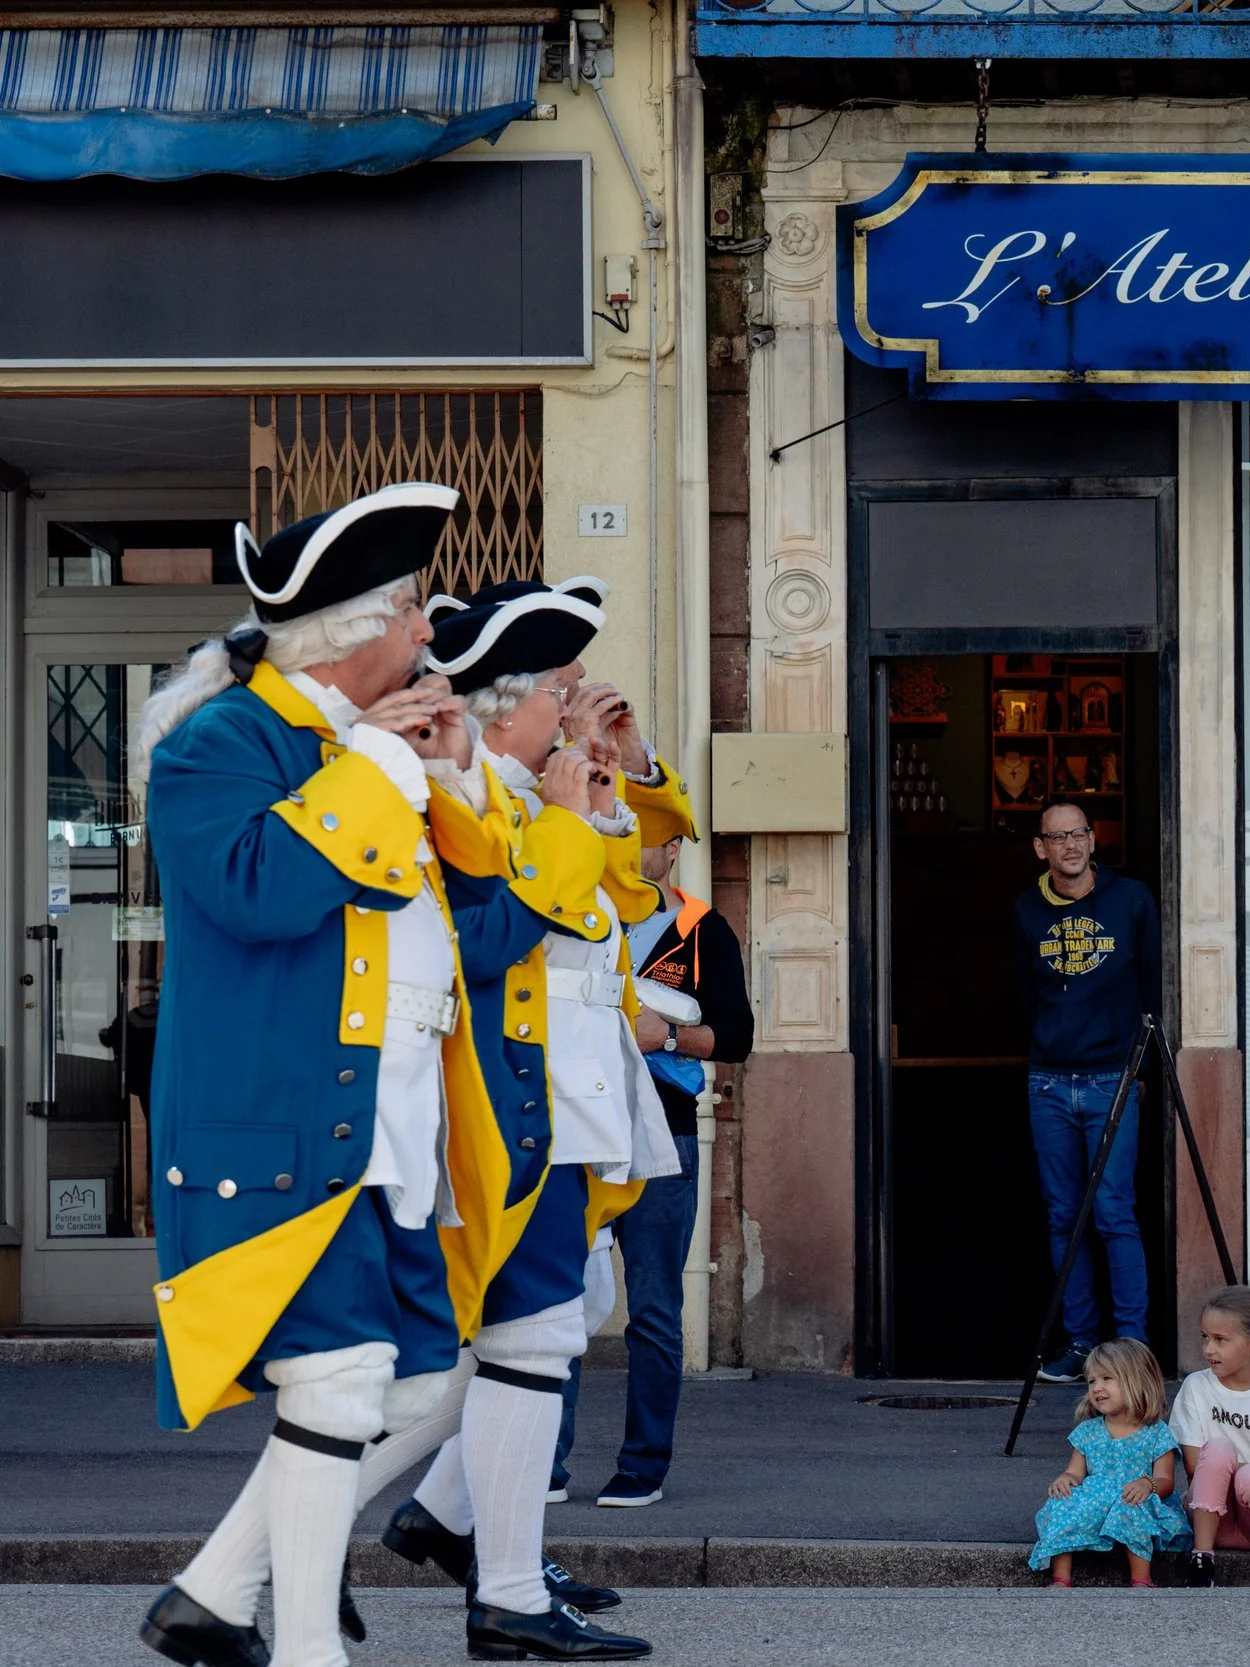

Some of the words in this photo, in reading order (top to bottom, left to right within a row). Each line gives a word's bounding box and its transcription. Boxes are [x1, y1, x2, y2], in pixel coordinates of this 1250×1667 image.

[590, 511, 615, 529] 12
[1040, 941, 1063, 955] URBAN
[1064, 939, 1115, 952] TRADEMARK
[55, 1222, 65, 1230] de
